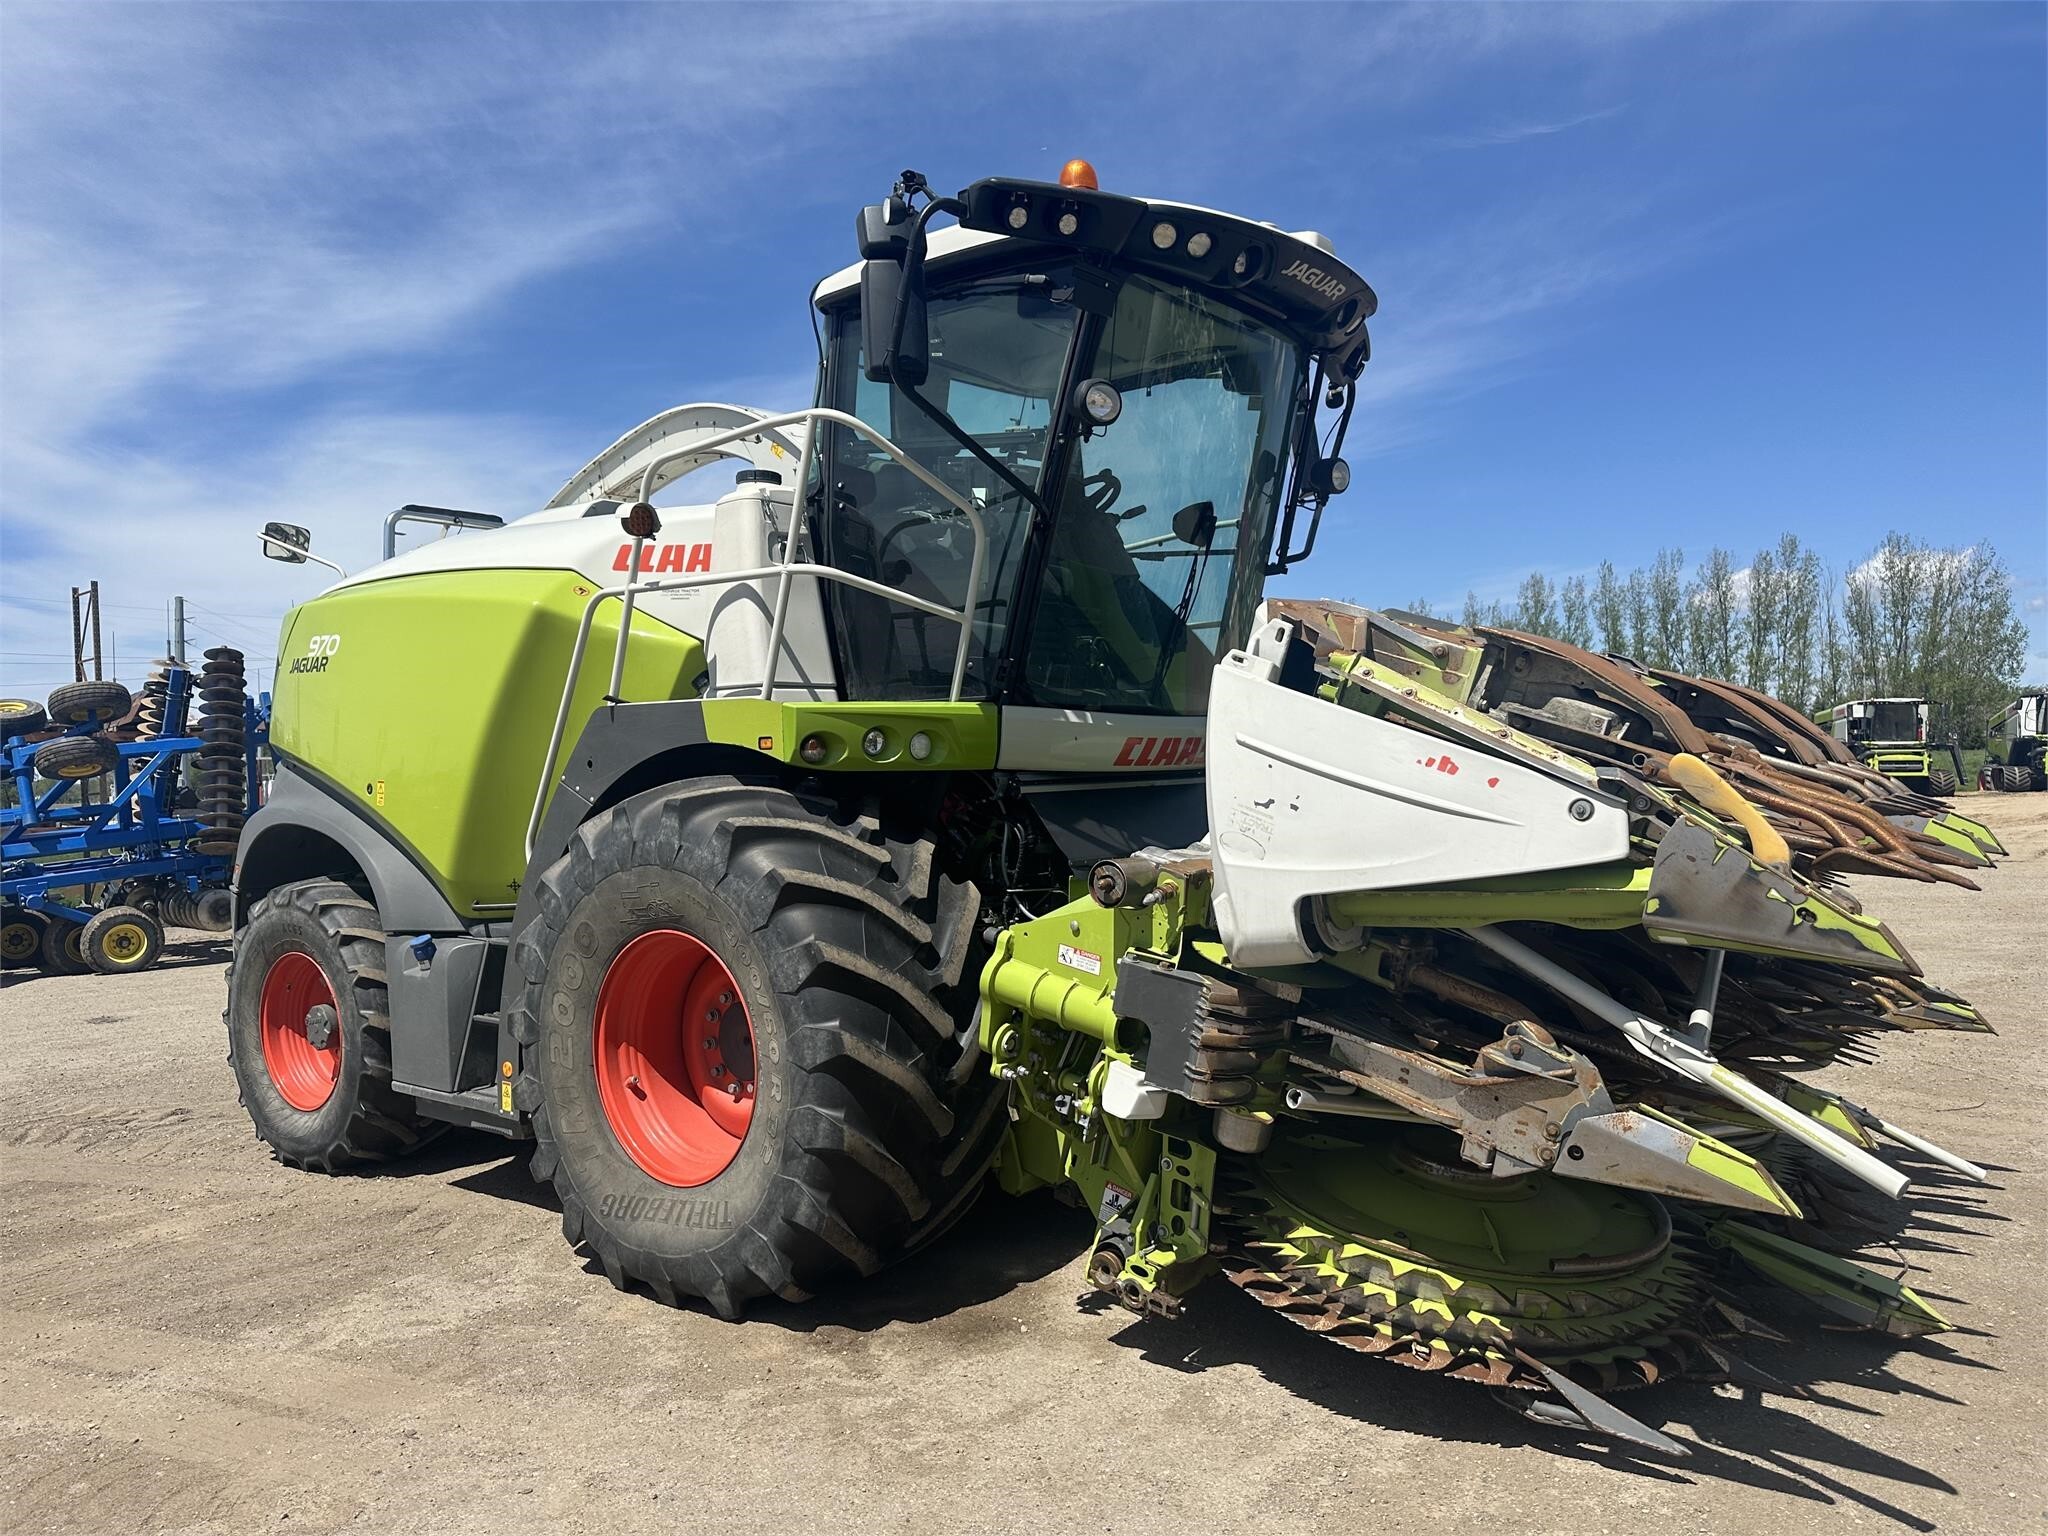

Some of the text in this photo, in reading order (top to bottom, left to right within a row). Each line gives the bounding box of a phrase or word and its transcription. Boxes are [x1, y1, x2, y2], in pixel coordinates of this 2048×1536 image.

[1281, 260, 1347, 301] JAGUAR
[307, 633, 341, 658] 970
[289, 656, 329, 674] JAGUAR
[1112, 736, 1204, 767] CLAA
[600, 1193, 733, 1229] TRELLEBORG
